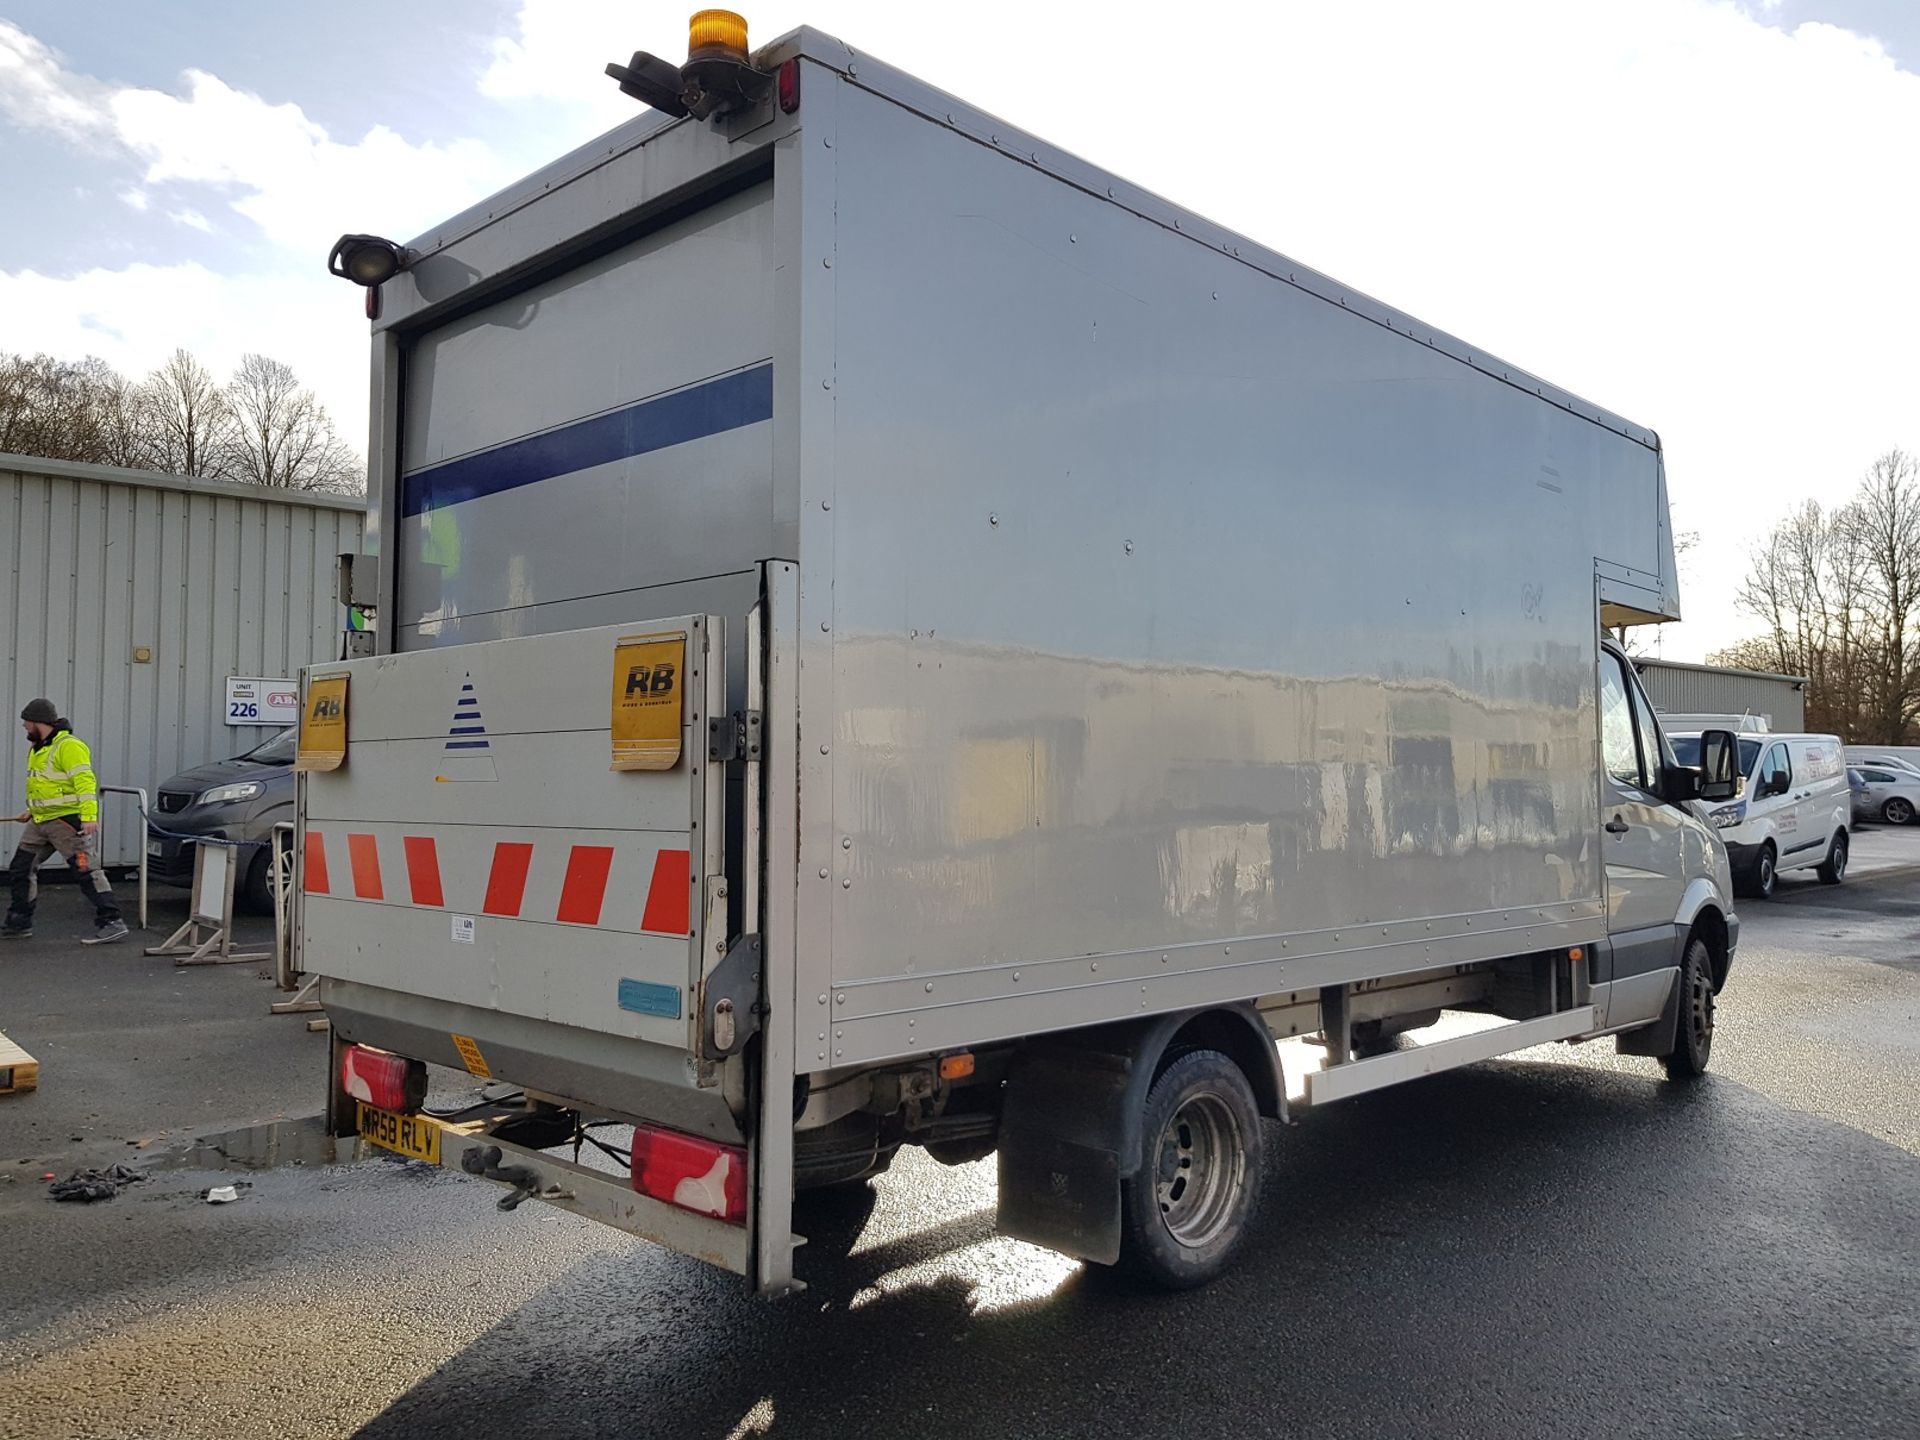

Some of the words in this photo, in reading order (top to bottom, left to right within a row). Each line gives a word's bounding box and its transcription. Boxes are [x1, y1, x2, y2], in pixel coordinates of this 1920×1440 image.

[624, 663, 675, 699] RB
[230, 702, 257, 717] 226
[312, 695, 341, 721] RB
[401, 1119, 434, 1156] RLV
